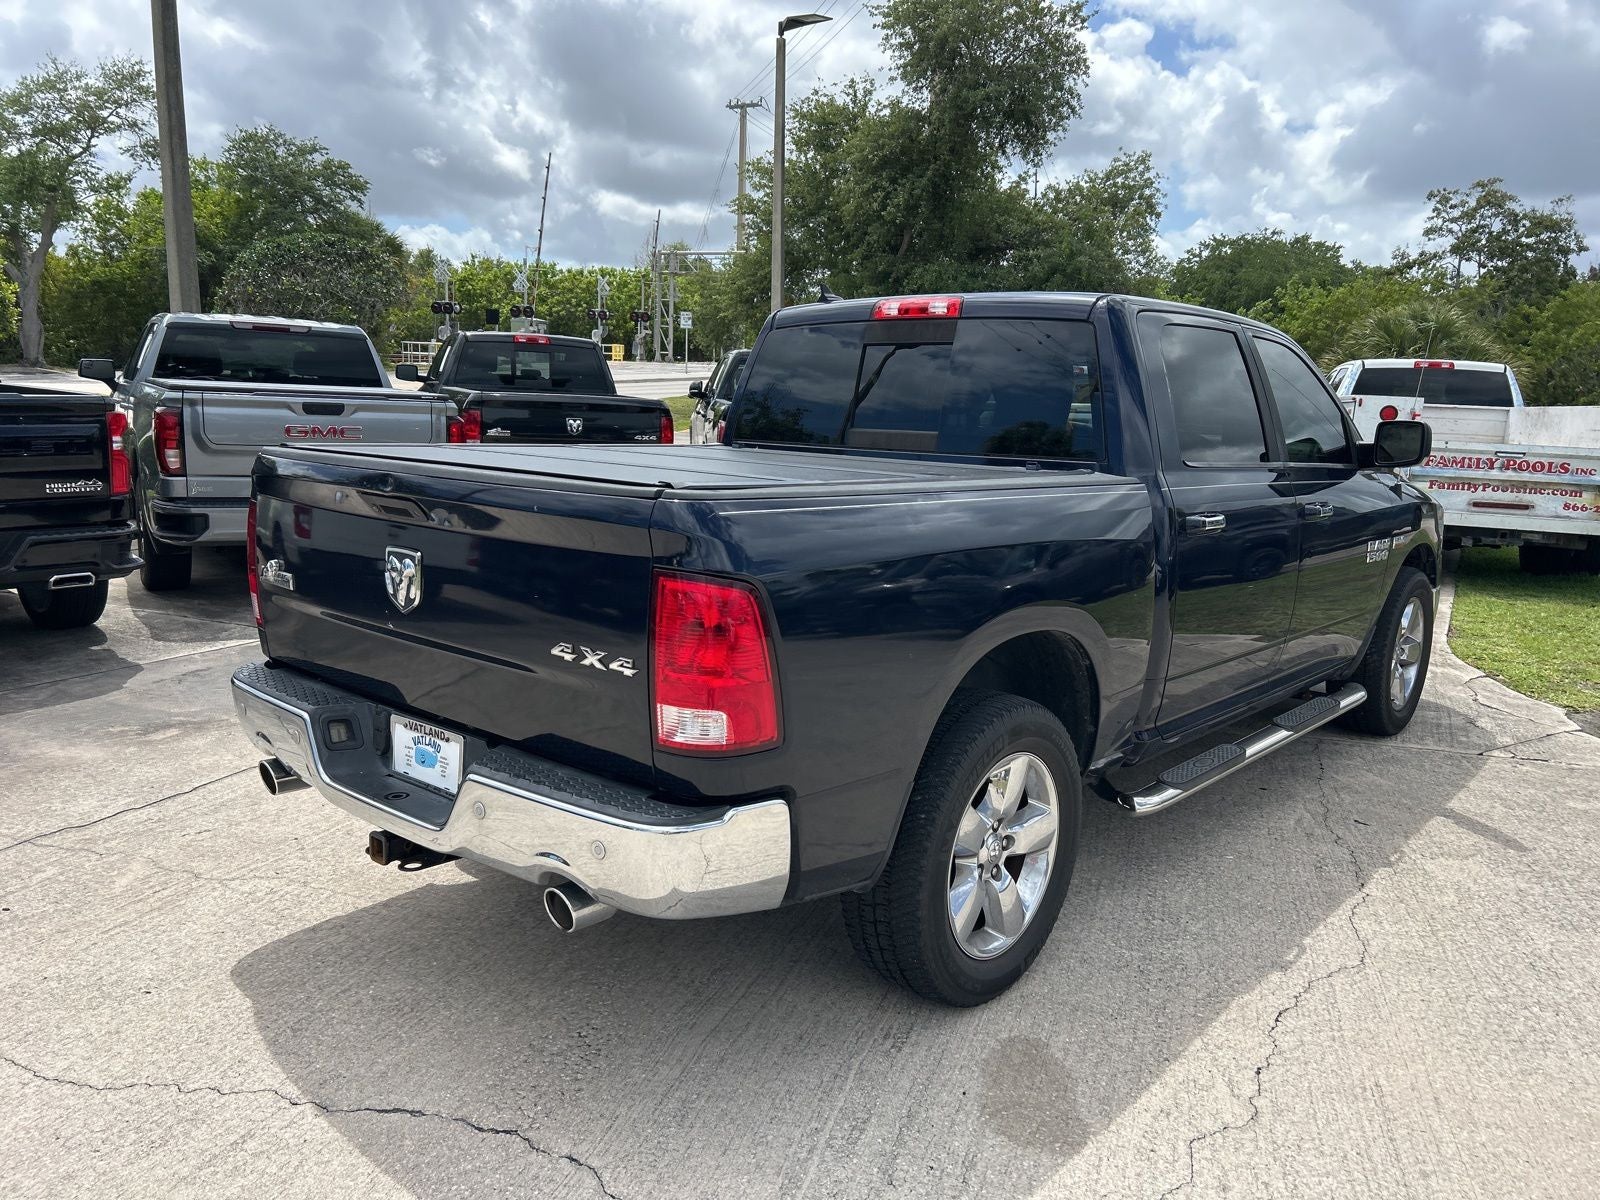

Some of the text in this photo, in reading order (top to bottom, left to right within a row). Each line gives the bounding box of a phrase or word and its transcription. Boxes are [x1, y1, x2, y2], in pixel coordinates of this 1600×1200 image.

[284, 424, 363, 440] GMC
[1424, 454, 1598, 476] FAMILY POOLS INC
[550, 641, 640, 678] 4X4
[408, 720, 445, 740] VATLAND
[411, 735, 442, 754] VATLAND
